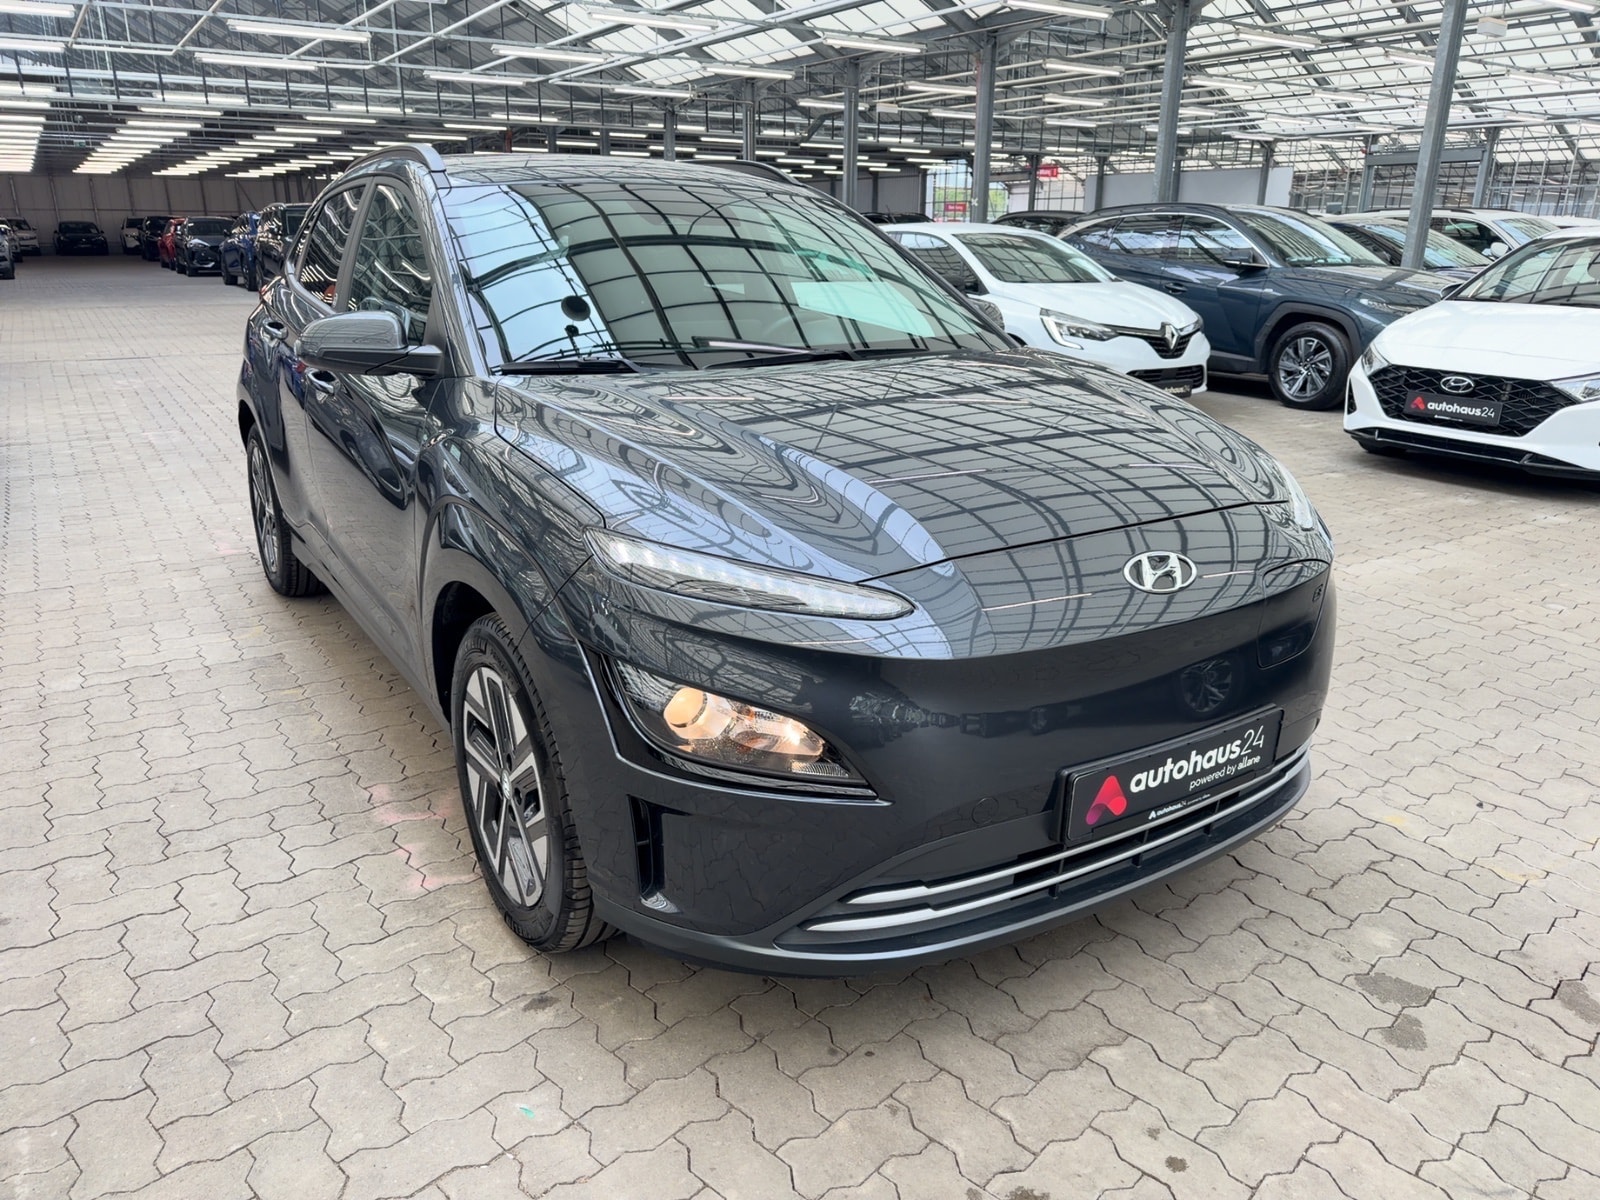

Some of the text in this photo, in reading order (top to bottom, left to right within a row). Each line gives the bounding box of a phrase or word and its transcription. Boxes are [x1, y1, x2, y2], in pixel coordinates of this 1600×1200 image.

[1427, 401, 1495, 418] autohaus24
[1130, 725, 1265, 793] autohaus24
[1189, 755, 1261, 791] powered by allane
